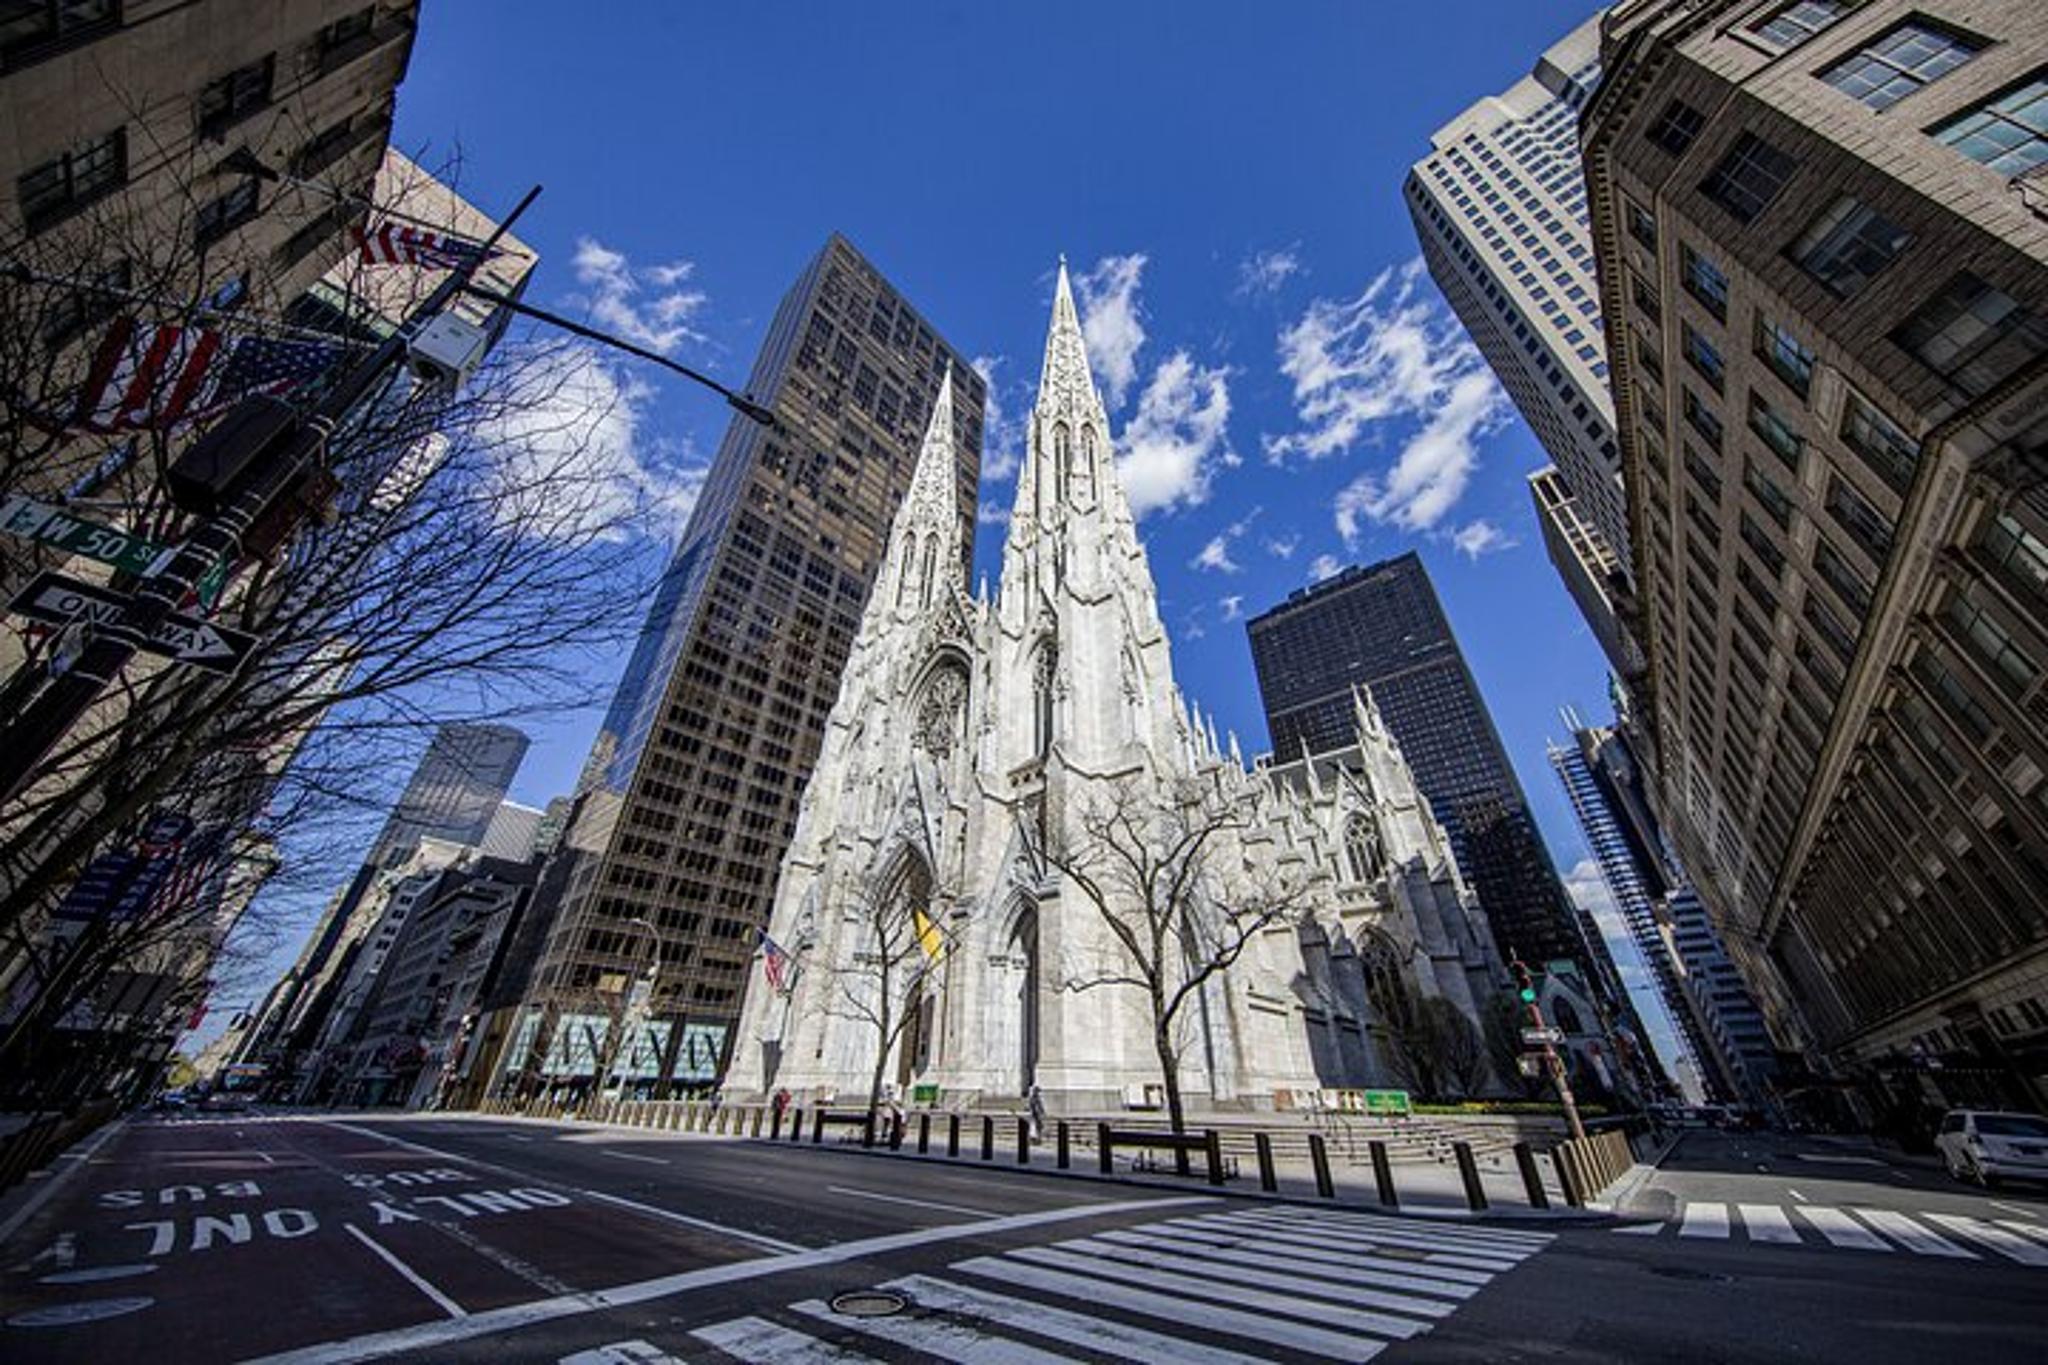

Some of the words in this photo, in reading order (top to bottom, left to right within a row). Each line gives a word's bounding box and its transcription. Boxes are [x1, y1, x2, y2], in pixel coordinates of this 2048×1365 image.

[41, 516, 81, 541] W
[76, 529, 129, 560] 50
[154, 624, 220, 652] WAY
[343, 1168, 483, 1188] BUS
[100, 1180, 263, 1208] BUS
[369, 1187, 573, 1224] ONLY
